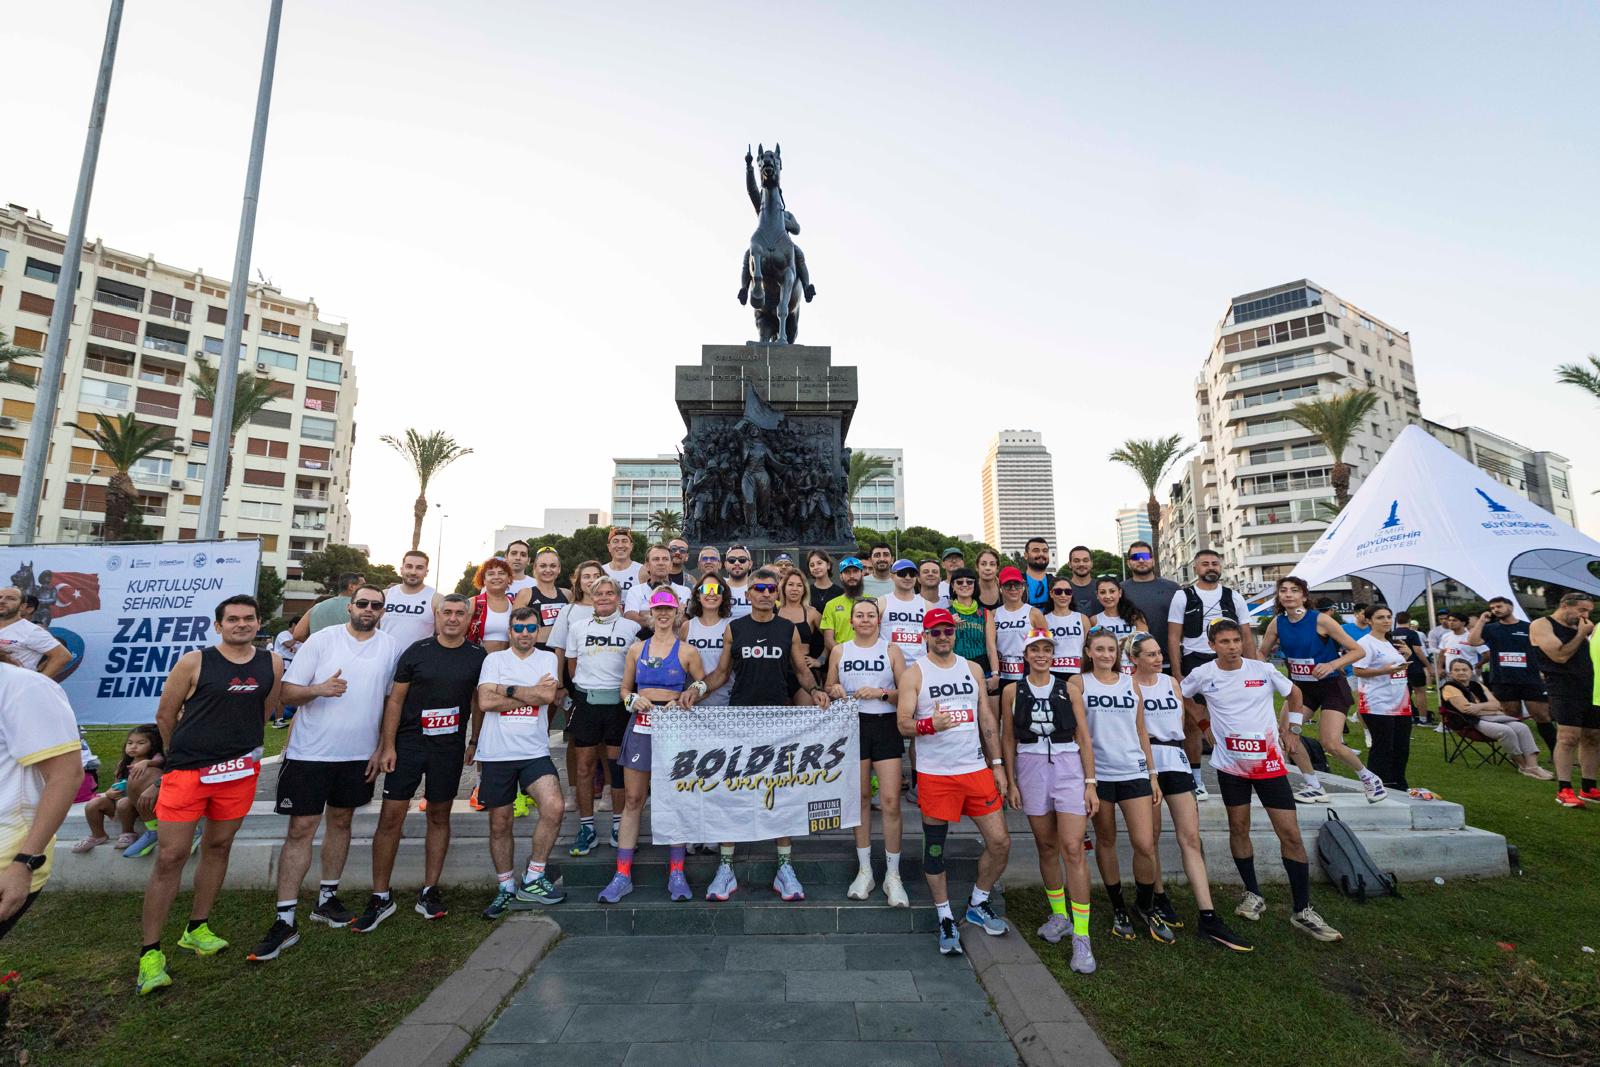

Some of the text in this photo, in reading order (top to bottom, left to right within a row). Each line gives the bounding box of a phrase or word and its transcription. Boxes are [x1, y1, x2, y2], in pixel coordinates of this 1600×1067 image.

[127, 578, 223, 594] KURTULUŞUN
[122, 594, 193, 612] ŞEHRİNDE
[385, 603, 425, 615] BOLD
[889, 612, 924, 623] BOLD
[112, 616, 211, 643] ZAFER
[585, 635, 626, 647] BOLD
[897, 633, 917, 642] 1995
[741, 645, 783, 659] BOLD
[105, 645, 205, 673] SENİ
[1054, 657, 1075, 665] 3231
[843, 660, 885, 672] BOLD
[97, 676, 168, 698] ELİN
[928, 682, 974, 699] BOLD
[1087, 695, 1135, 708] BOLD
[1143, 697, 1178, 711] OLD
[427, 715, 455, 727] 2714
[640, 714, 651, 725] 15
[949, 710, 968, 722] 599
[1231, 739, 1260, 751] 1603
[208, 758, 245, 774] 2656
[668, 737, 849, 782] BOLDERS
[675, 776, 719, 793] are
[810, 800, 840, 811] FORTUNE
[811, 816, 840, 832] BOLD
